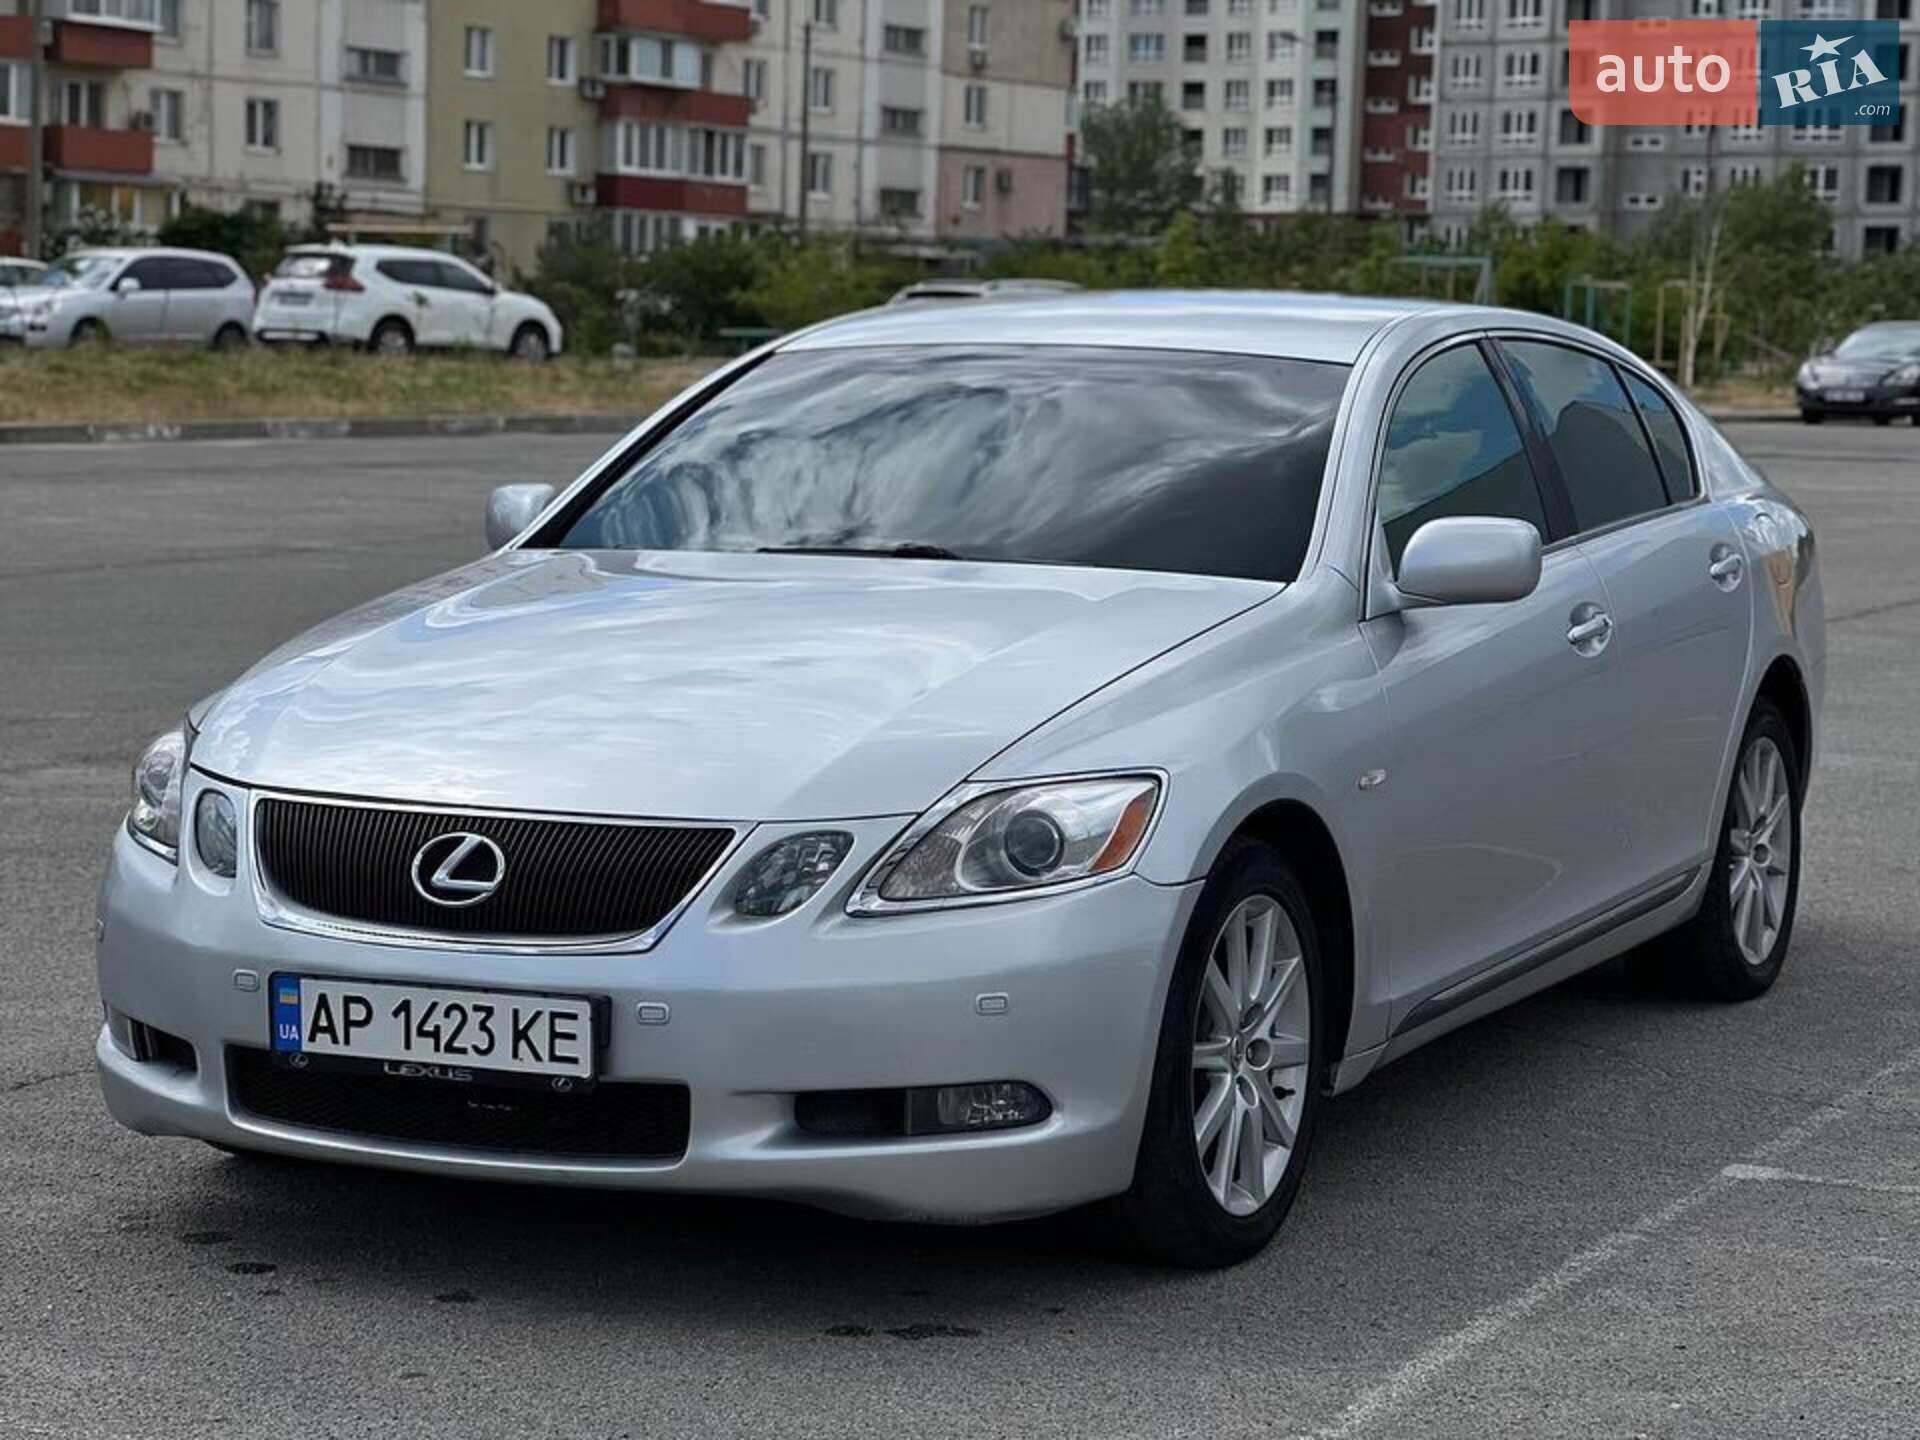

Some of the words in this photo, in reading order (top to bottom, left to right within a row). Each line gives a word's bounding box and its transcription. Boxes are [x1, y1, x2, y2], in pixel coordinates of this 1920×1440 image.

[279, 1023, 299, 1040] UA
[307, 993, 373, 1046] AP
[392, 999, 495, 1056] 1423
[510, 1008, 579, 1064] KE
[383, 1062, 473, 1081] LEXUS
